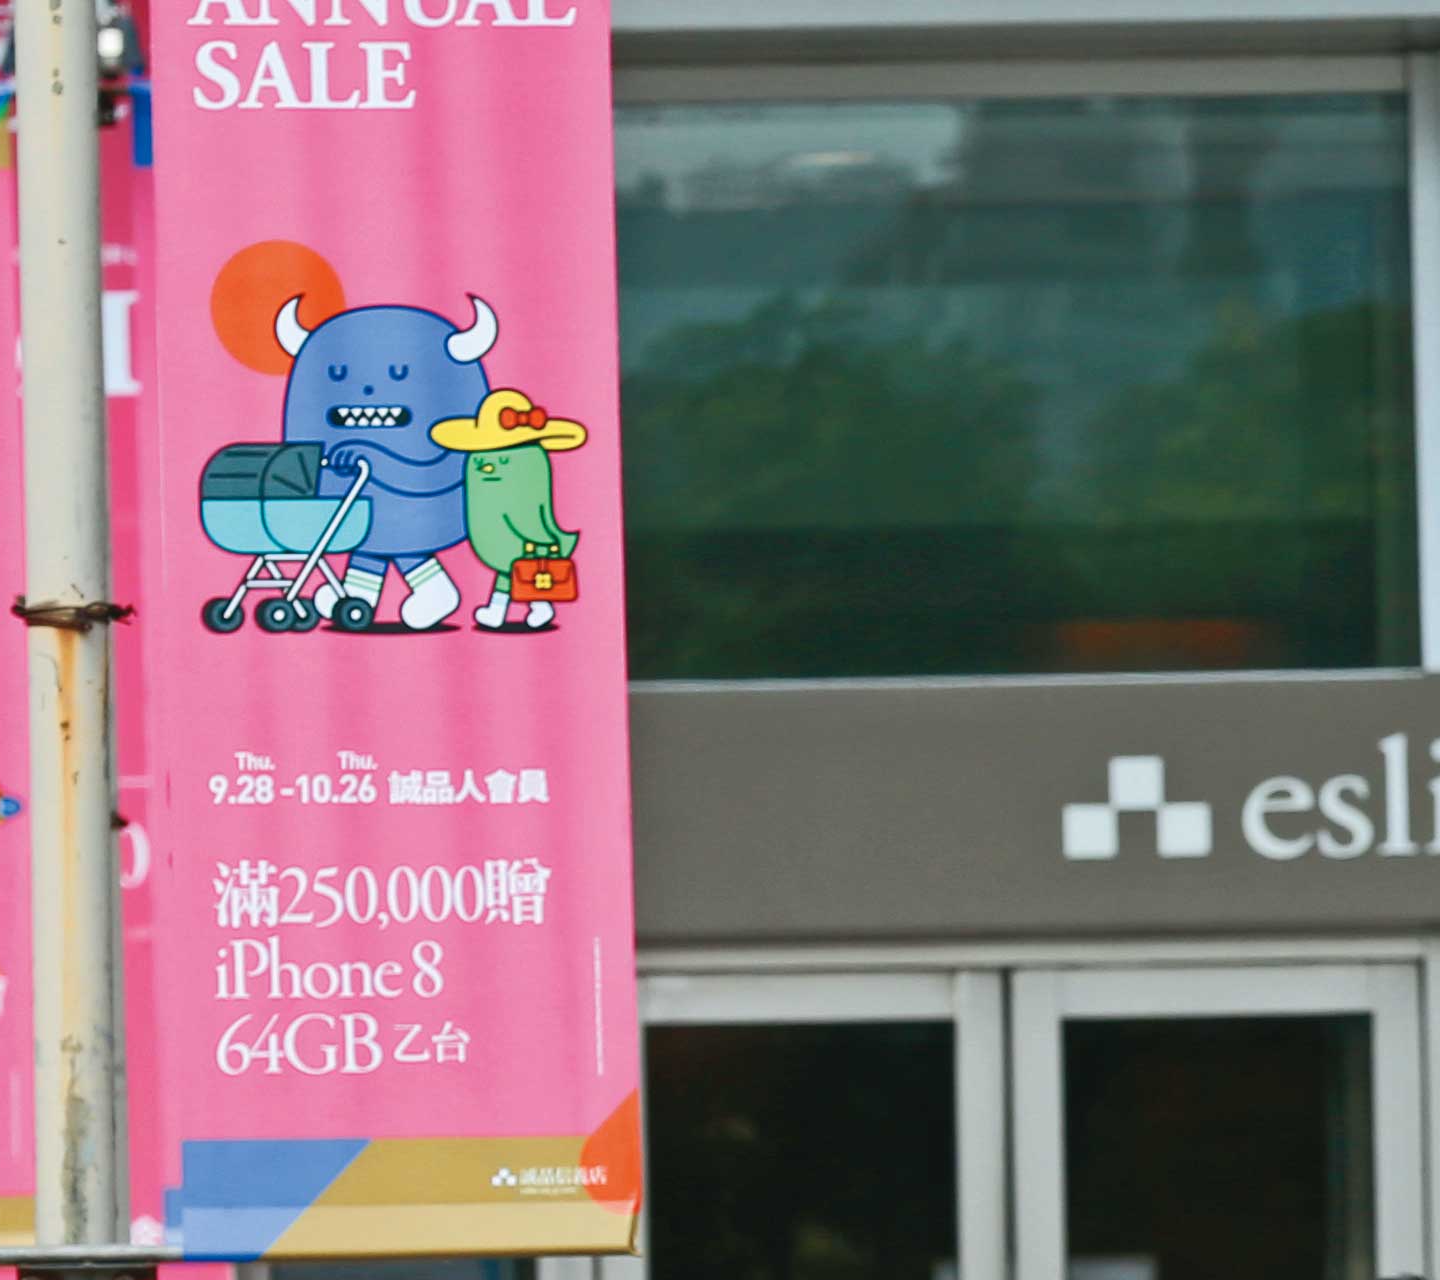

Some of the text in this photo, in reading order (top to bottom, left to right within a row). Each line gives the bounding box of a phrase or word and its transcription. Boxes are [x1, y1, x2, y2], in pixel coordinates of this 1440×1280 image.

[193, 41, 417, 110] SALE
[235, 751, 378, 770] Thu. Thu.
[388, 769, 550, 804] 誠品人會員
[213, 857, 552, 929] 滿250,000贈
[215, 935, 444, 1000] iPhone 8
[216, 1012, 471, 1076] 64GB 乙台
